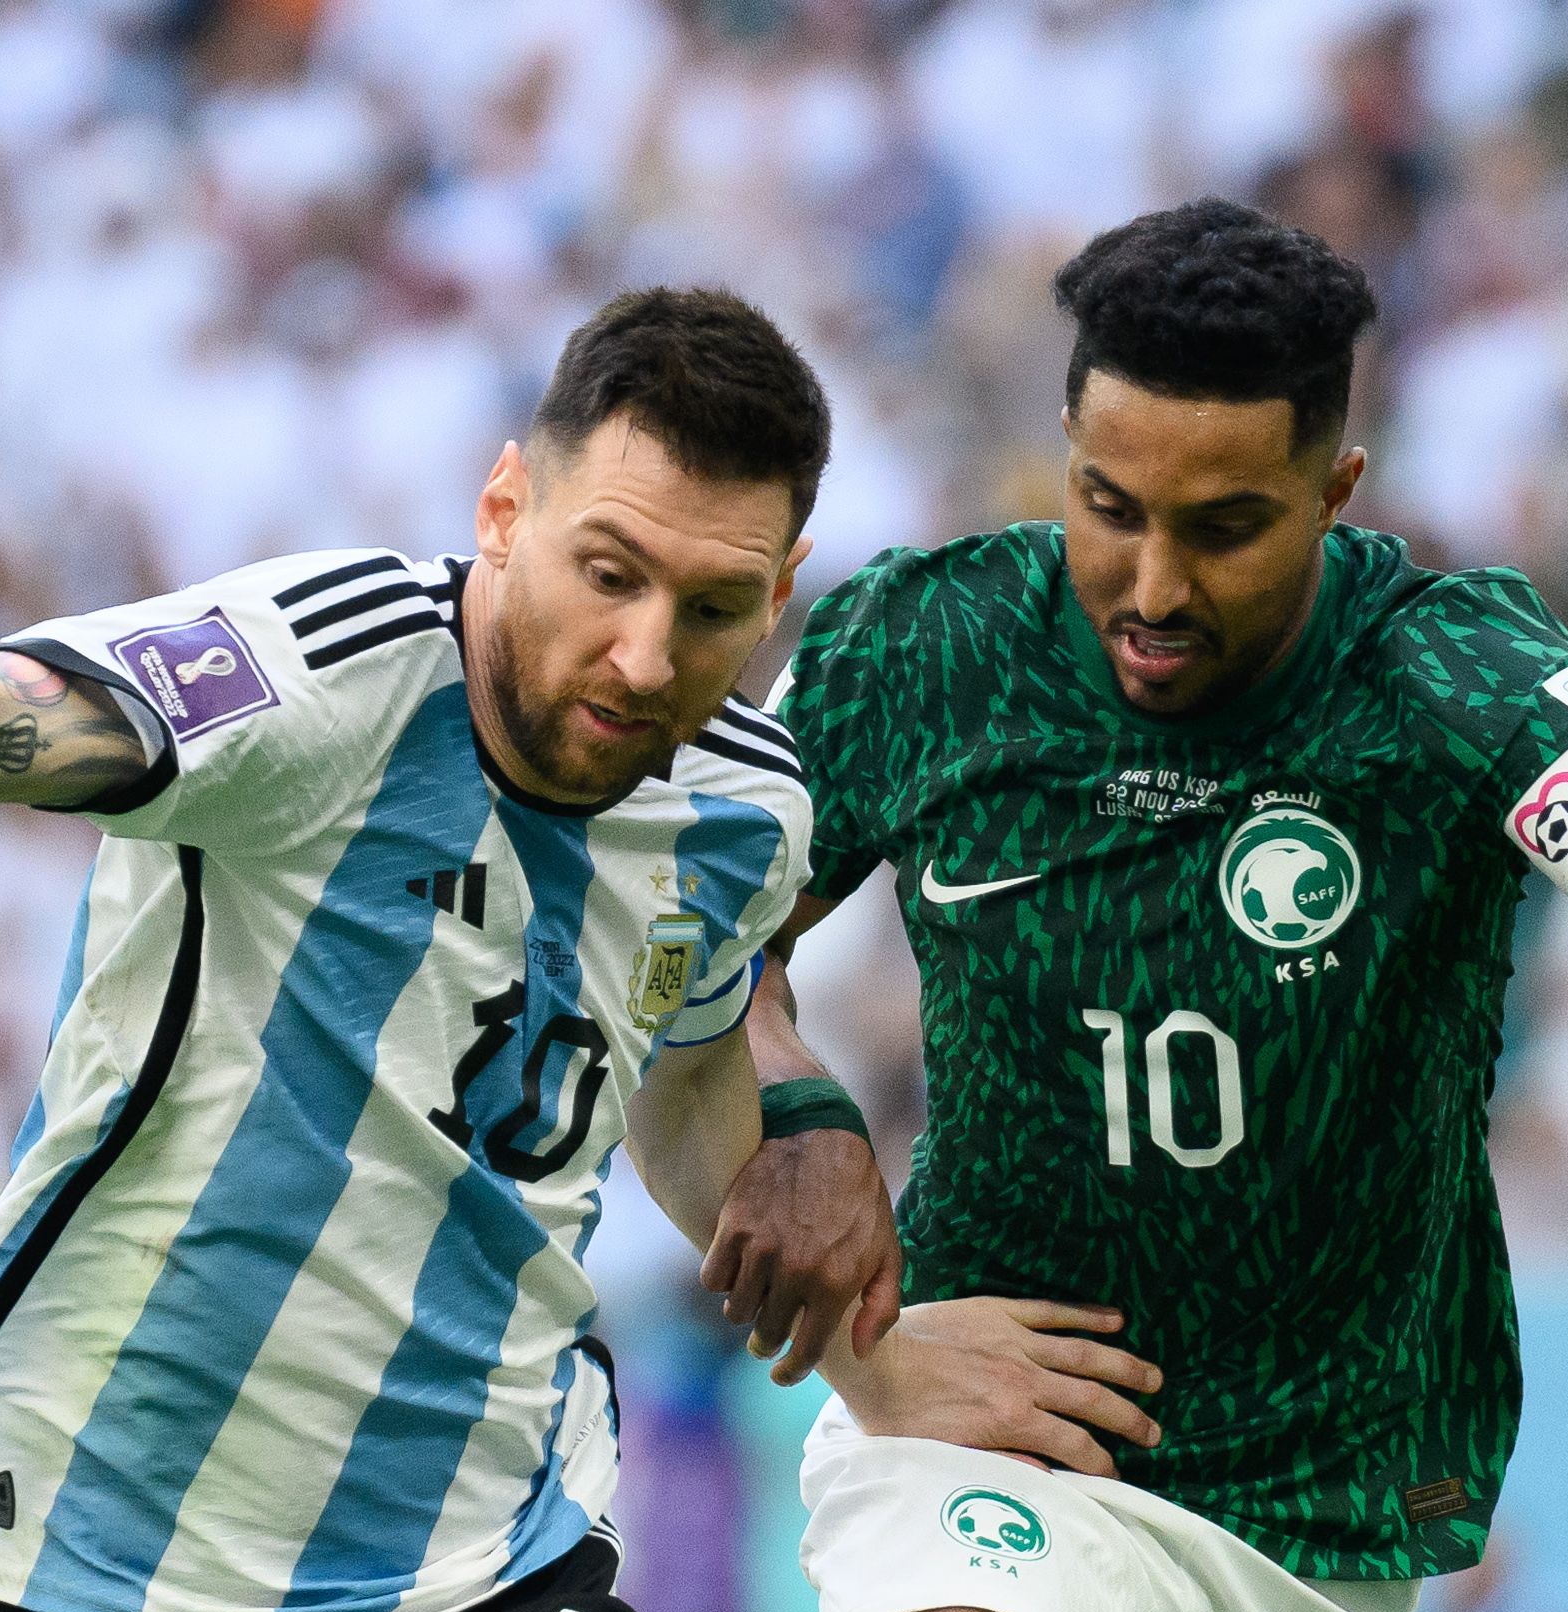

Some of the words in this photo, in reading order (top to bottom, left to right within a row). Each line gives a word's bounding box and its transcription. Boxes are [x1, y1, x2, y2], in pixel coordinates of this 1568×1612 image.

[157, 664, 179, 699] WORLD
[1106, 783, 1128, 803] 22
[1118, 769, 1153, 785] ARG
[1297, 886, 1336, 905] SAFF
[647, 946, 686, 1000] AFA
[1275, 951, 1340, 983] KSA
[427, 978, 609, 1184] 10
[1082, 1008, 1245, 1169] 10
[970, 1556, 1018, 1578] KSA
